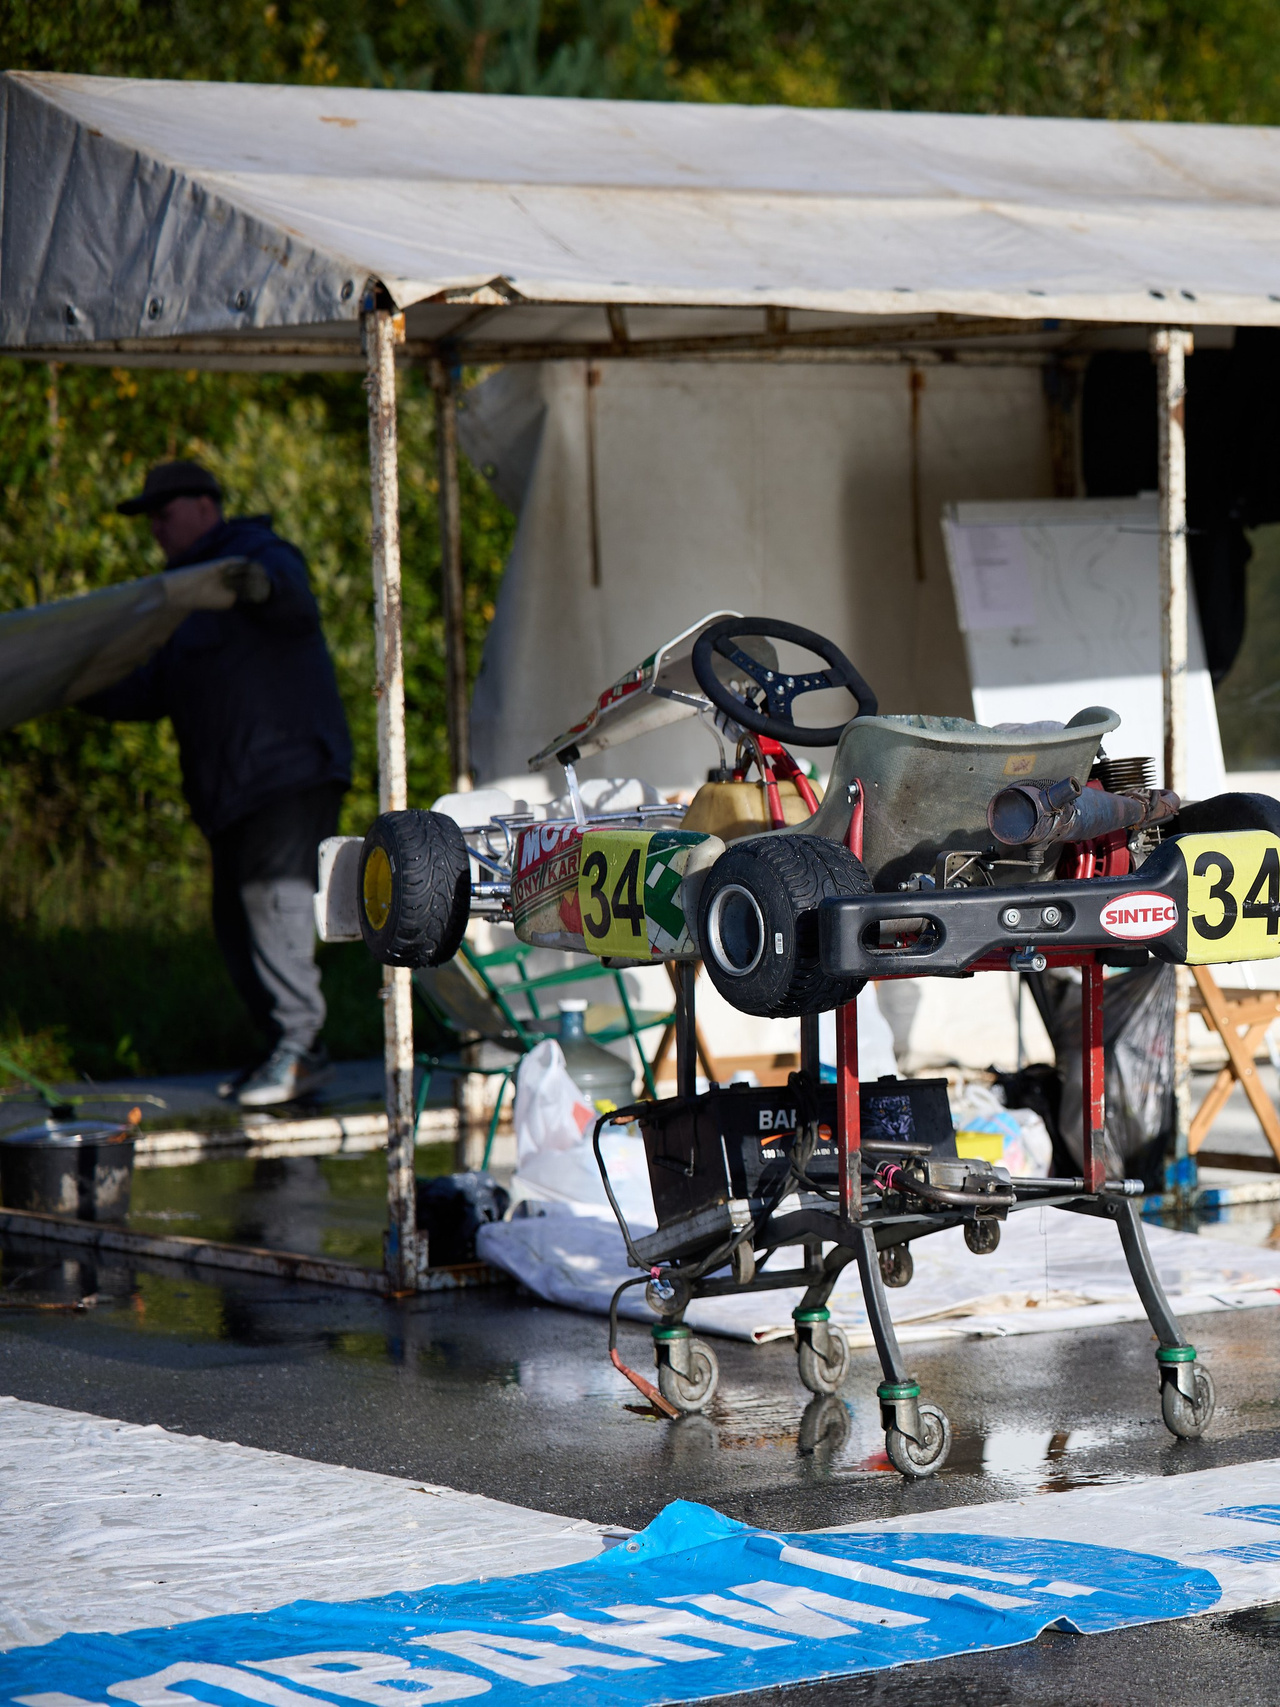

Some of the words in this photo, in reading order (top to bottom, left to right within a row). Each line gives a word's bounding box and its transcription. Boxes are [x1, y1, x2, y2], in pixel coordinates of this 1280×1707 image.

[548, 855, 581, 884] KAR
[582, 849, 645, 939] 34
[1105, 907, 1176, 925] SINTEC
